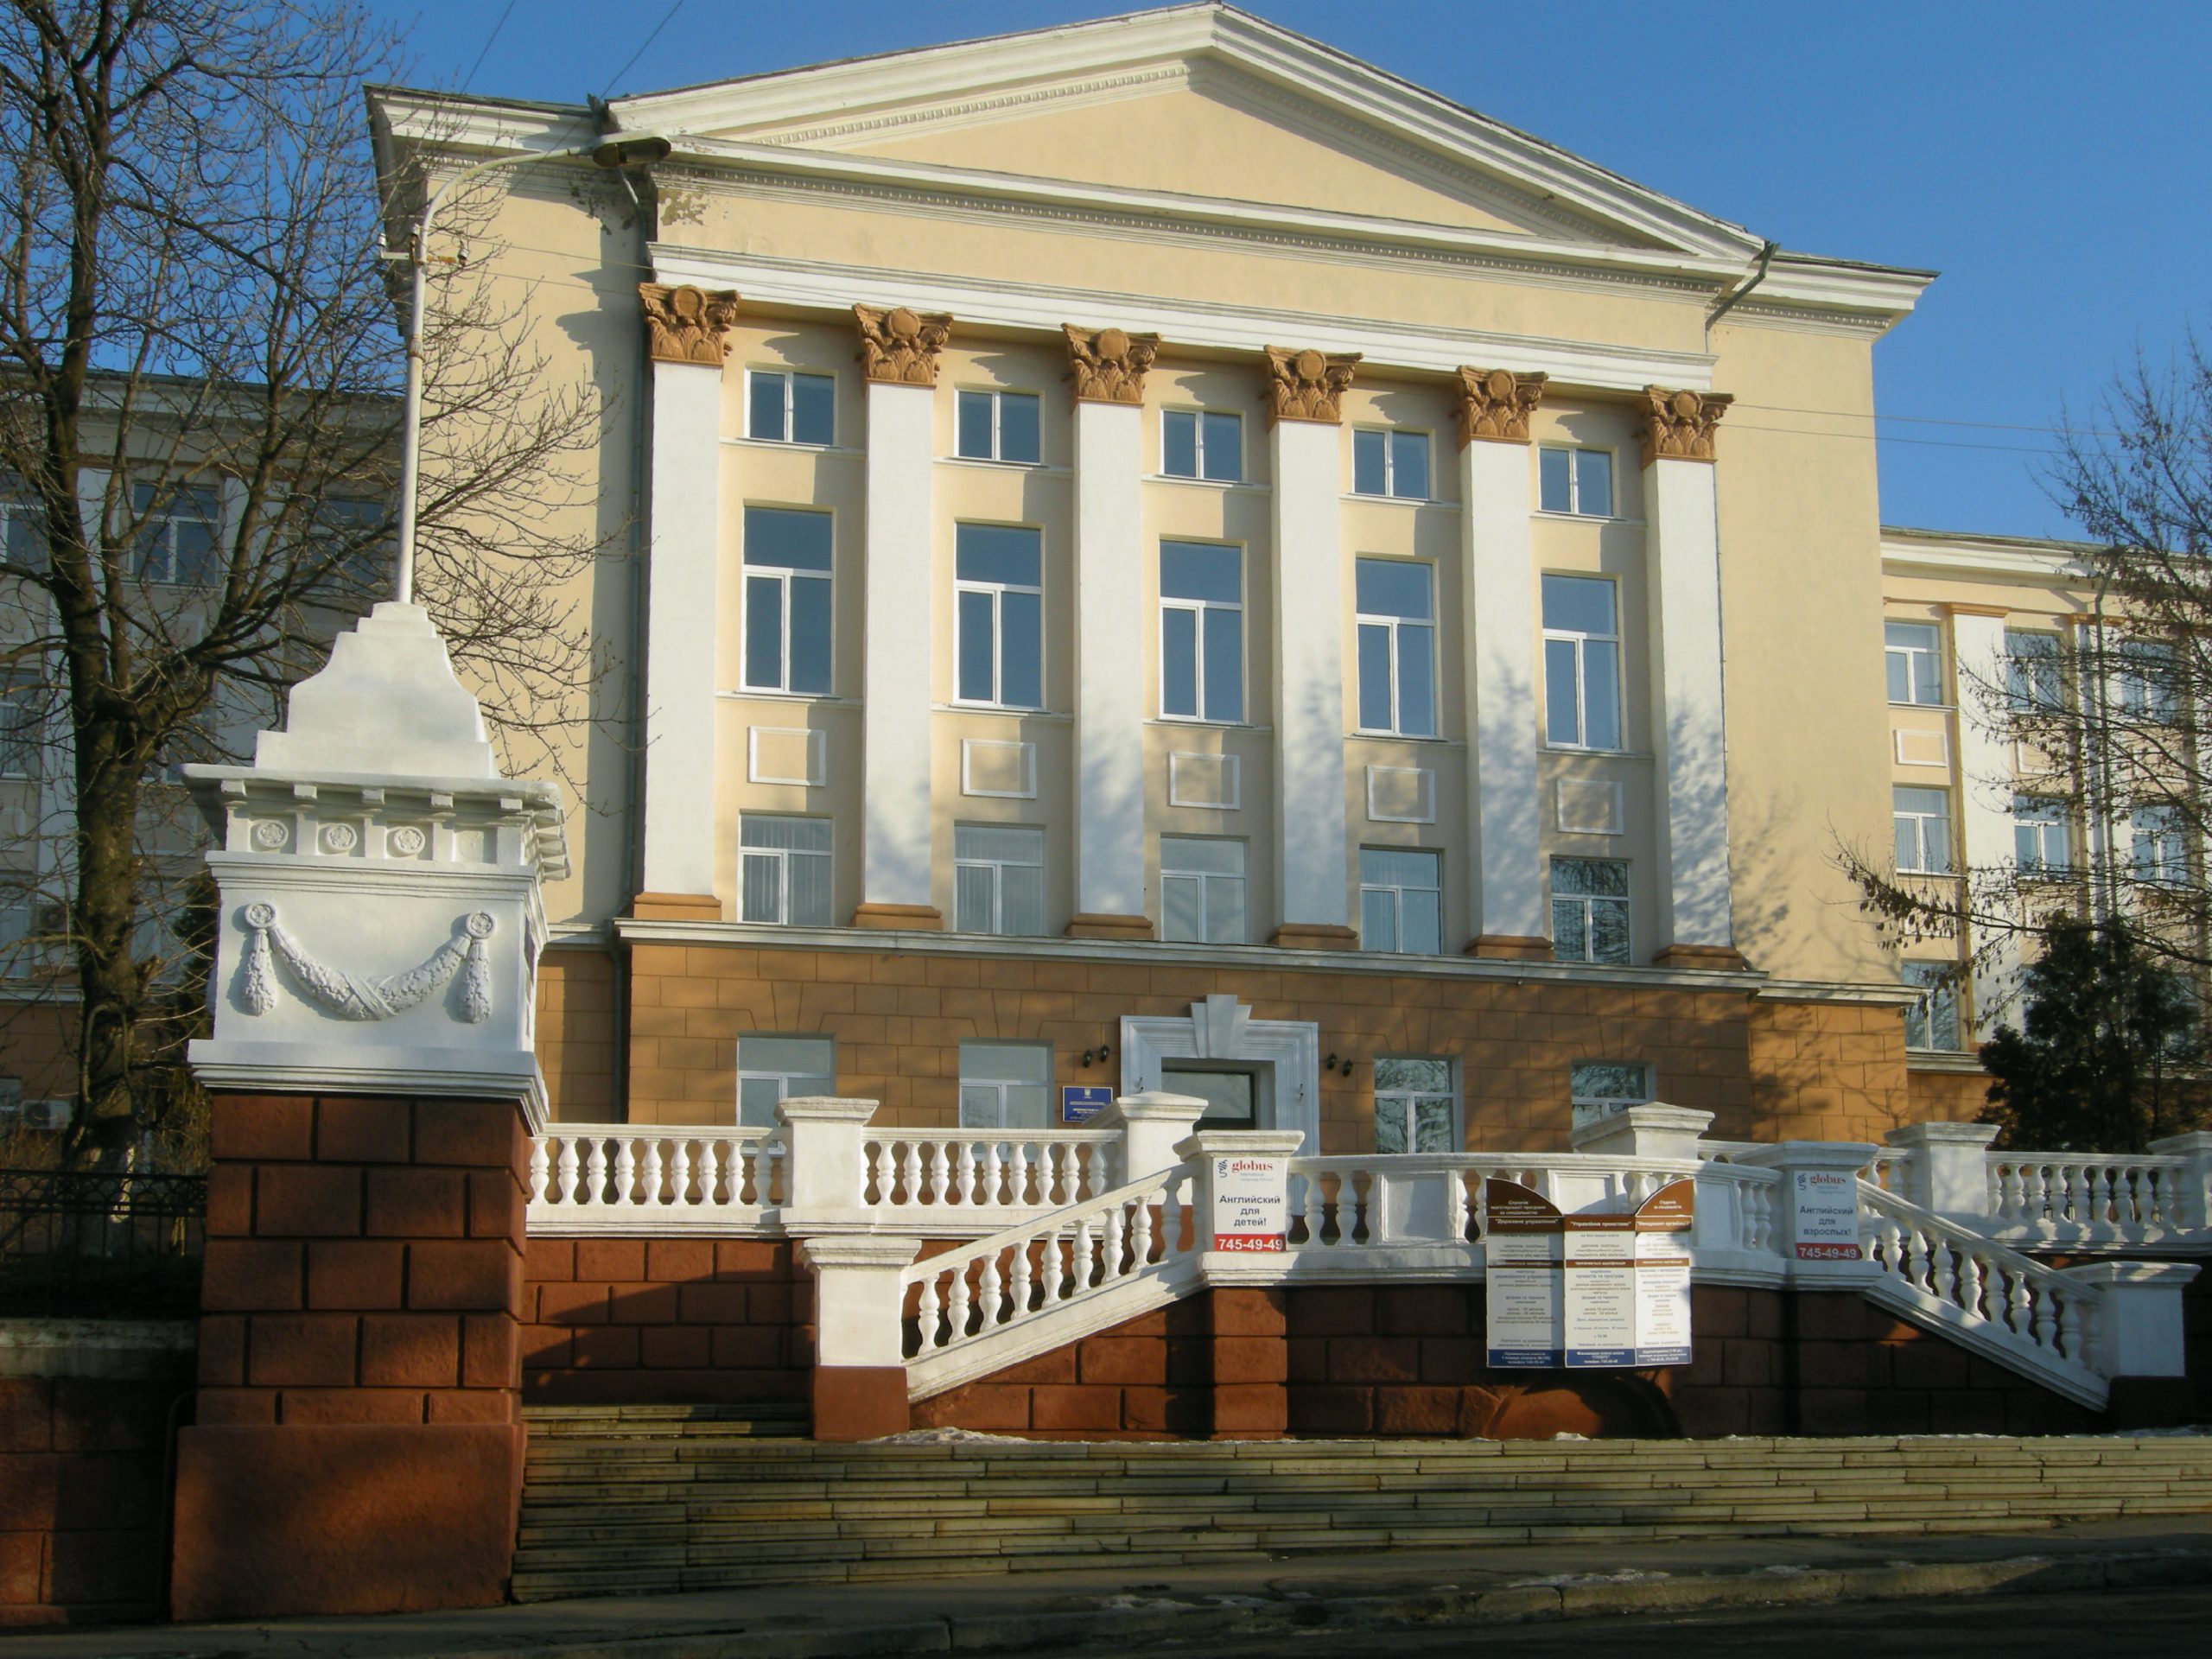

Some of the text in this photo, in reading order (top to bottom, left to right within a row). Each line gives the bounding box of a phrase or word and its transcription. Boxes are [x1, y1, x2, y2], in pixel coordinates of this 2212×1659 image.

[1231, 1160, 1273, 1173] globus
[1809, 1173, 1847, 1186] globus
[1219, 1194, 1281, 1204] Английский
[1799, 1205, 1853, 1215] Английский
[1234, 1217, 1267, 1227] детей!
[1803, 1228, 1852, 1237] взрослых!
[1218, 1238, 1283, 1250] 745-49-49
[1799, 1247, 1857, 1259] 745-49-49
